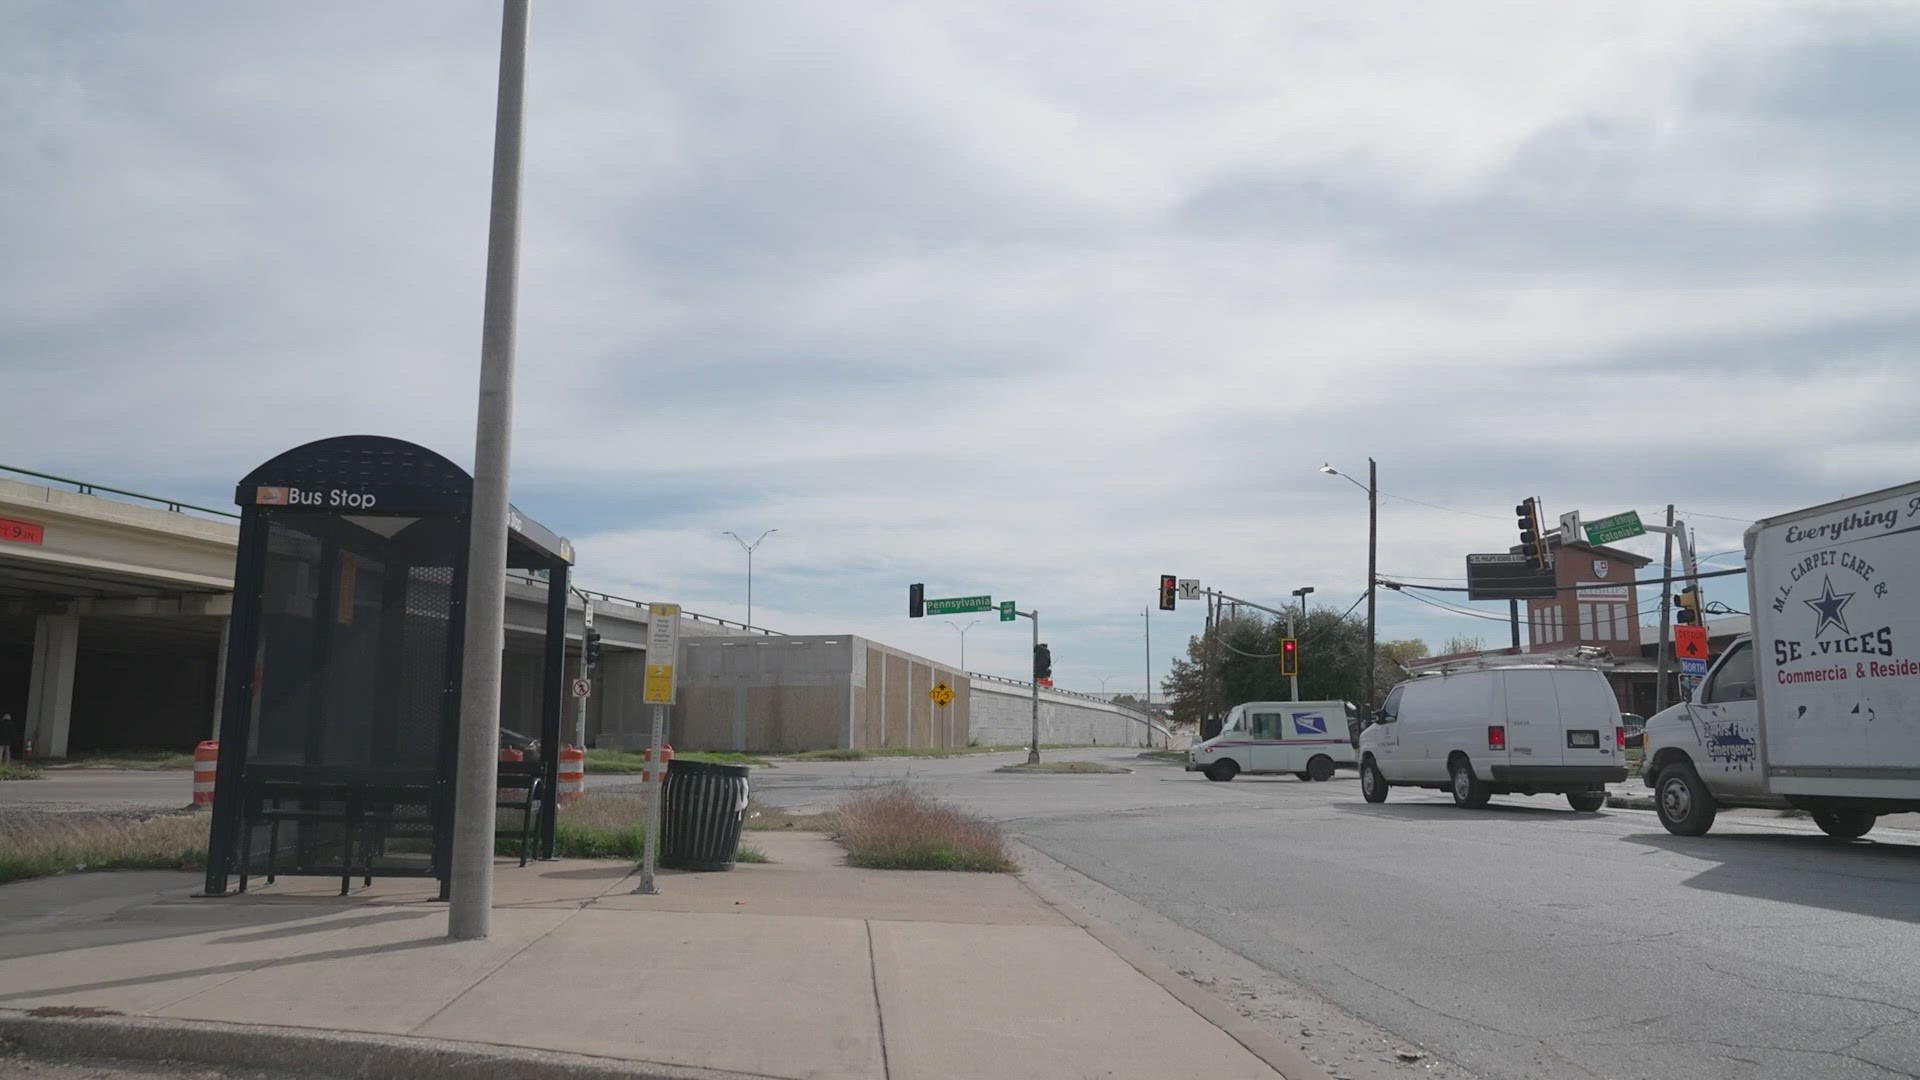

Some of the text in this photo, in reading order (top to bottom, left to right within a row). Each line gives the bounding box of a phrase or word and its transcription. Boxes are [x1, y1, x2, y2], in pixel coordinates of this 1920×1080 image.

[289, 488, 376, 509] Bus Stop
[13, 526, 22, 538] 9
[1600, 526, 1635, 542] Colonial
[1785, 509, 1898, 543] Everything
[1773, 550, 1888, 613] M.L. CARPET CARE &
[928, 596, 990, 610] Pennsylvania
[1774, 626, 1892, 666] SEVICES
[1682, 661, 1706, 672] NORTH
[1856, 662, 1865, 678] &
[1870, 658, 1920, 678] Reside
[1707, 741, 1756, 761] Emergency
